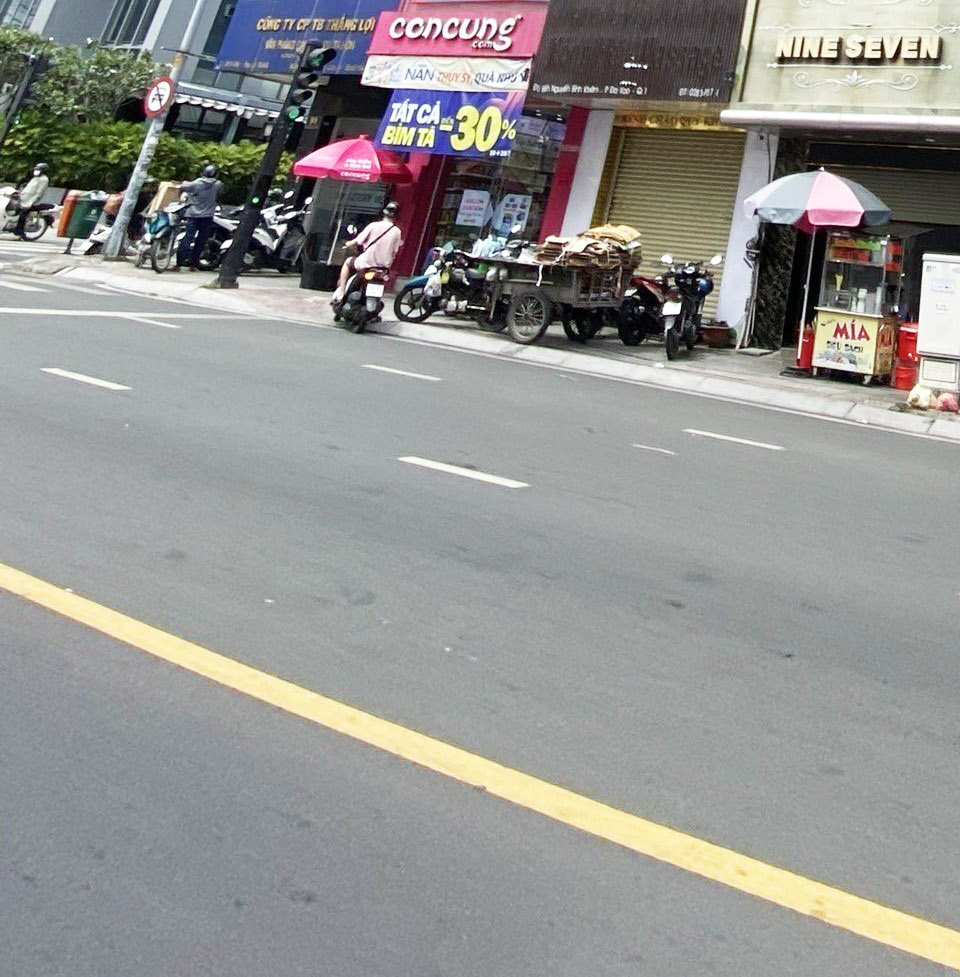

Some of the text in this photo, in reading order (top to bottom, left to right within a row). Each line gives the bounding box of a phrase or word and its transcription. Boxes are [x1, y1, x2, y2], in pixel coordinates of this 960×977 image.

[284, 18, 296, 31] TY
[296, 18, 311, 31] CP
[312, 19, 326, 32] TB
[389, 14, 523, 51] concung
[775, 34, 943, 61] NINE SEVEN
[390, 98, 441, 125] TẤT CẢ
[832, 319, 871, 342] MÍA
